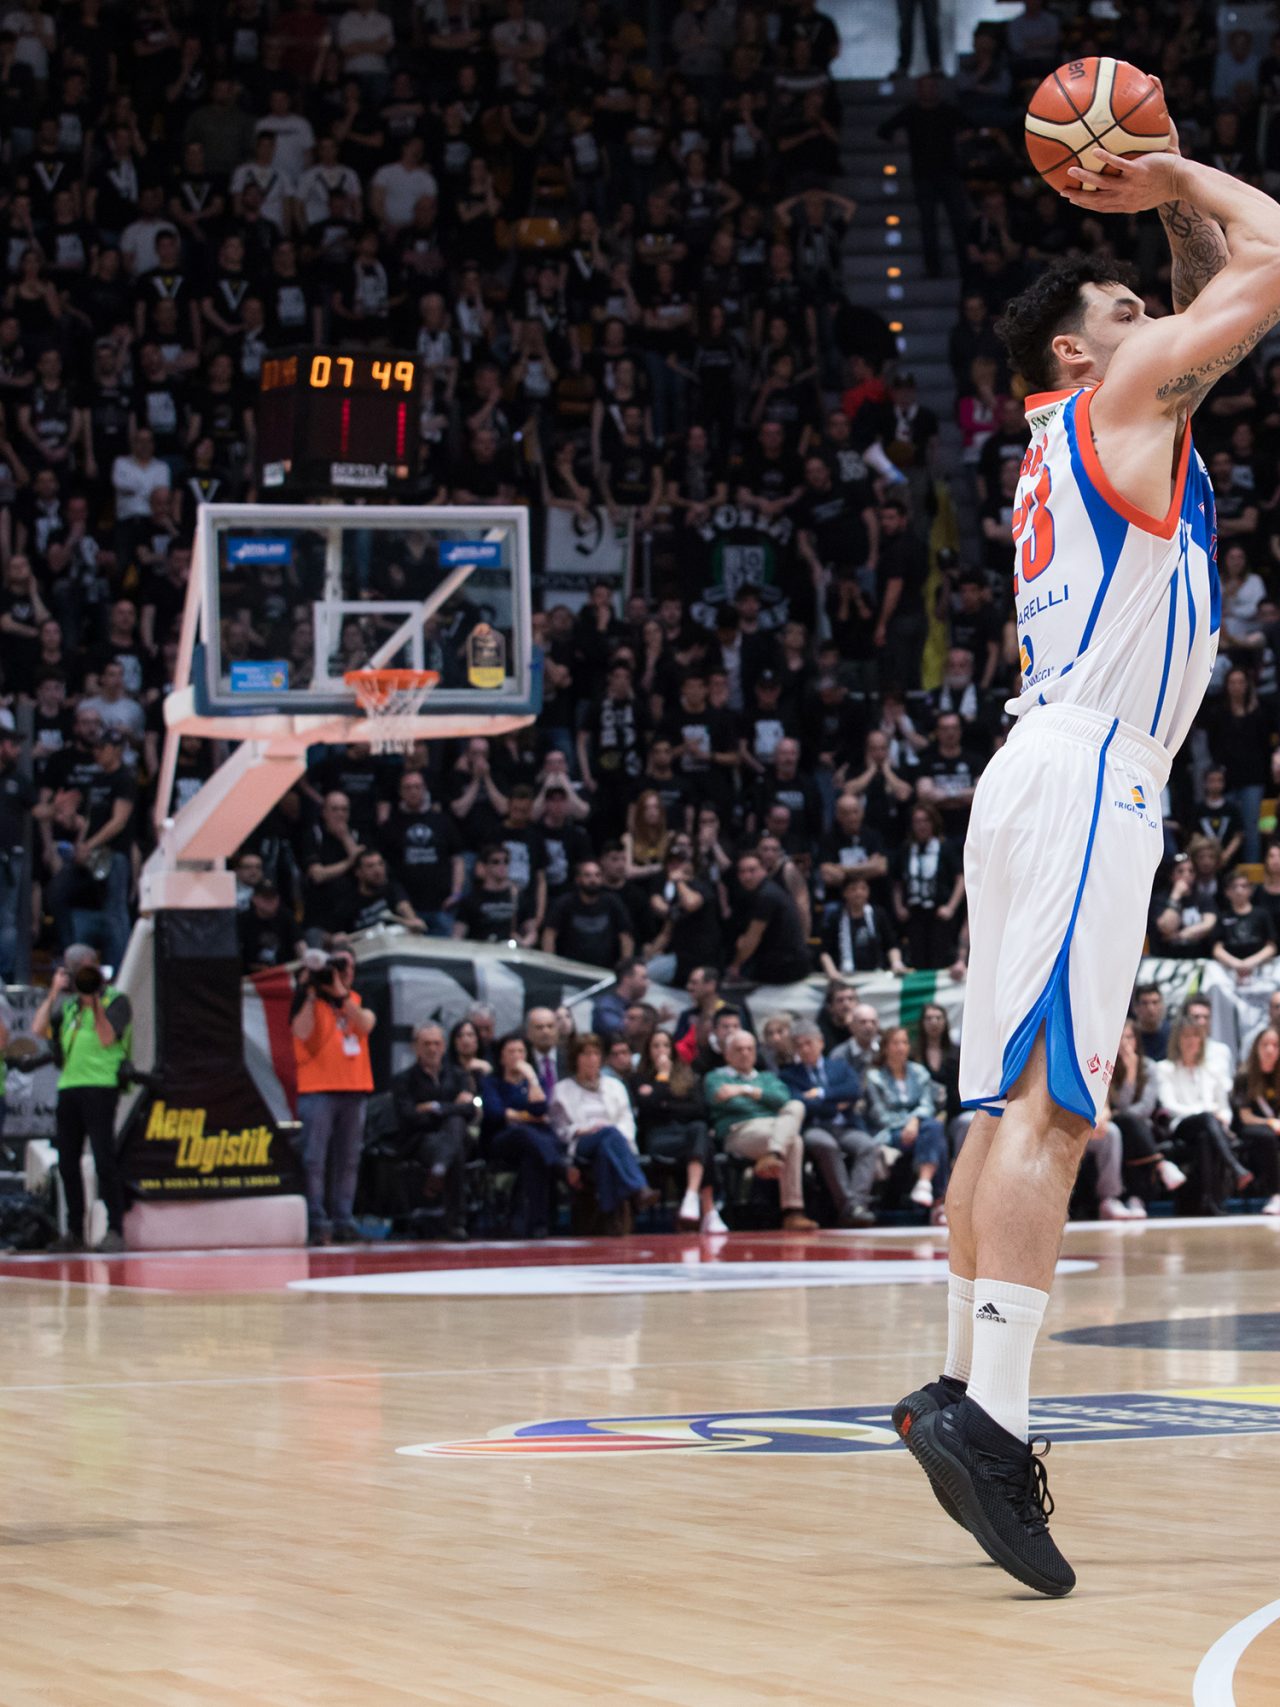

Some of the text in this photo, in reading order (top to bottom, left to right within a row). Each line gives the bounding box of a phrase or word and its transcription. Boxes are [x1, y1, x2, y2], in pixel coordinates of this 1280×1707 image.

[310, 355, 354, 389] 07
[371, 360, 415, 392] 49
[145, 1100, 206, 1140] Aero
[175, 1125, 274, 1174] Logistik
[975, 1312, 1007, 1324] adidas
